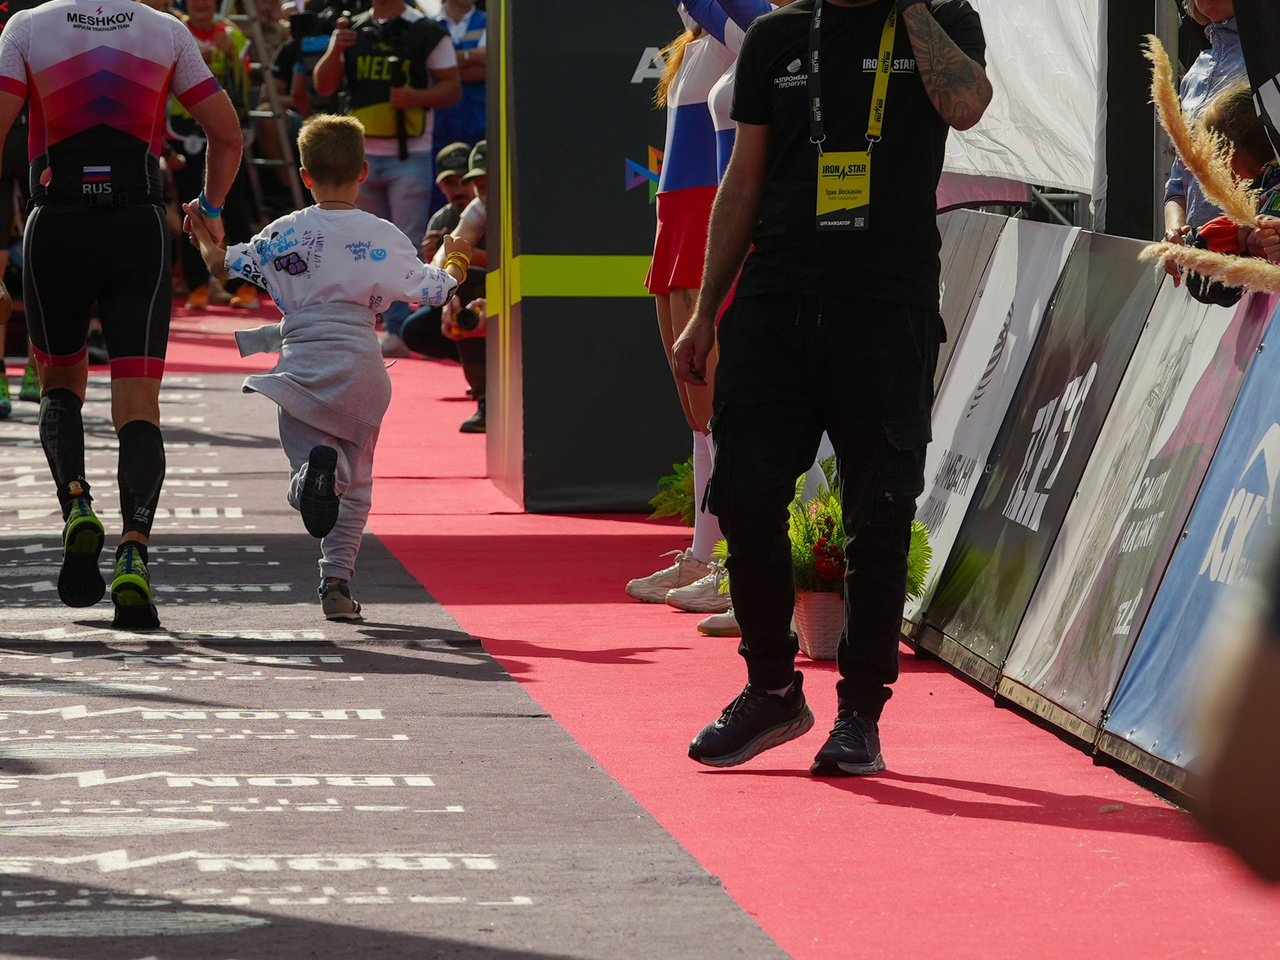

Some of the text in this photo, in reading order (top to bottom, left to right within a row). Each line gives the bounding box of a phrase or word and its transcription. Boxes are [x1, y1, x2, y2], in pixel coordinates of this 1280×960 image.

[67, 12, 134, 26] MESHKOV
[862, 58, 915, 70] IRO STAR
[823, 164, 866, 174] IRON STAR
[82, 183, 112, 194] RUS
[142, 710, 384, 721] IRON
[168, 776, 435, 788] IRON
[197, 857, 498, 872] IRON
